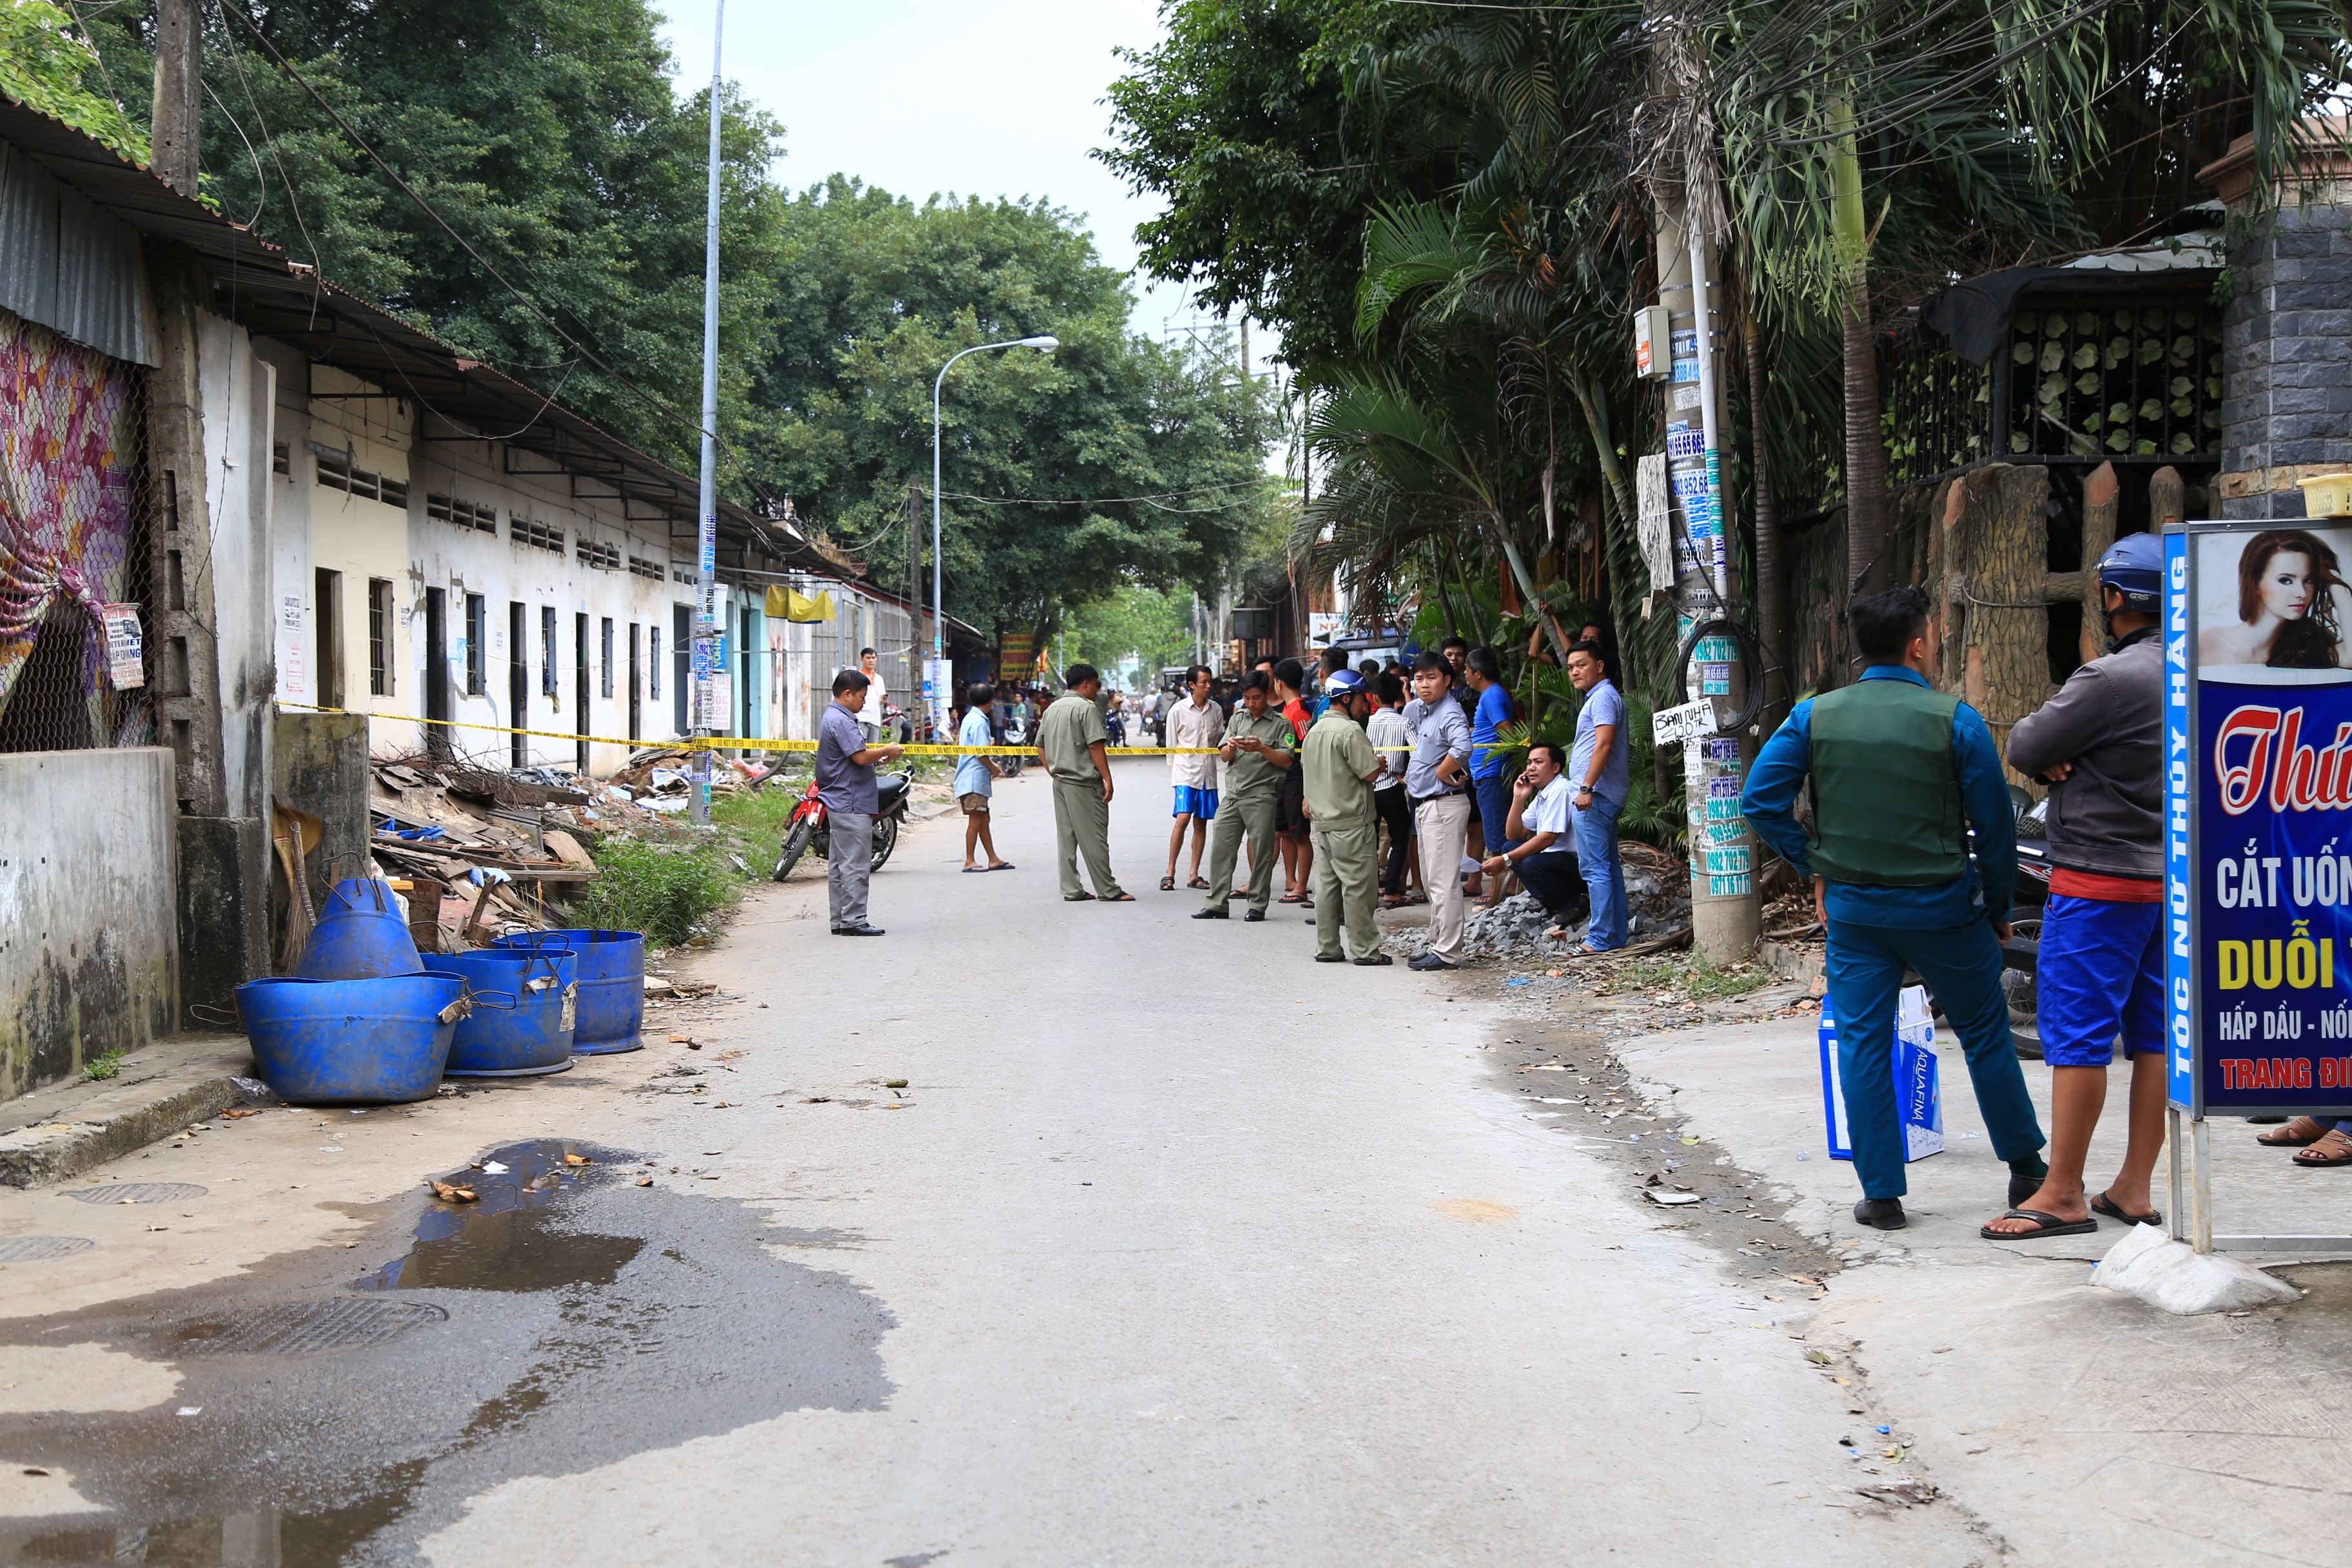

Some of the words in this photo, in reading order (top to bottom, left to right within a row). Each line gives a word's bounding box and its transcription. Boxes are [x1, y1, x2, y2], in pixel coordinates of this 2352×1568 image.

[2167, 556, 2186, 707] HẰNG
[2168, 726, 2188, 863] THÚY
[2217, 838, 2281, 908] CẮT
[2169, 874, 2189, 958] NỮ
[2218, 919, 2334, 990] DUỖI
[2171, 977, 2191, 1078] TÓC
[2219, 1001, 2257, 1041] HẤP
[2264, 1000, 2301, 1040] DẦU
[1912, 1048, 1928, 1121] AQUAFINA
[2220, 1057, 2312, 1090] TRANG
